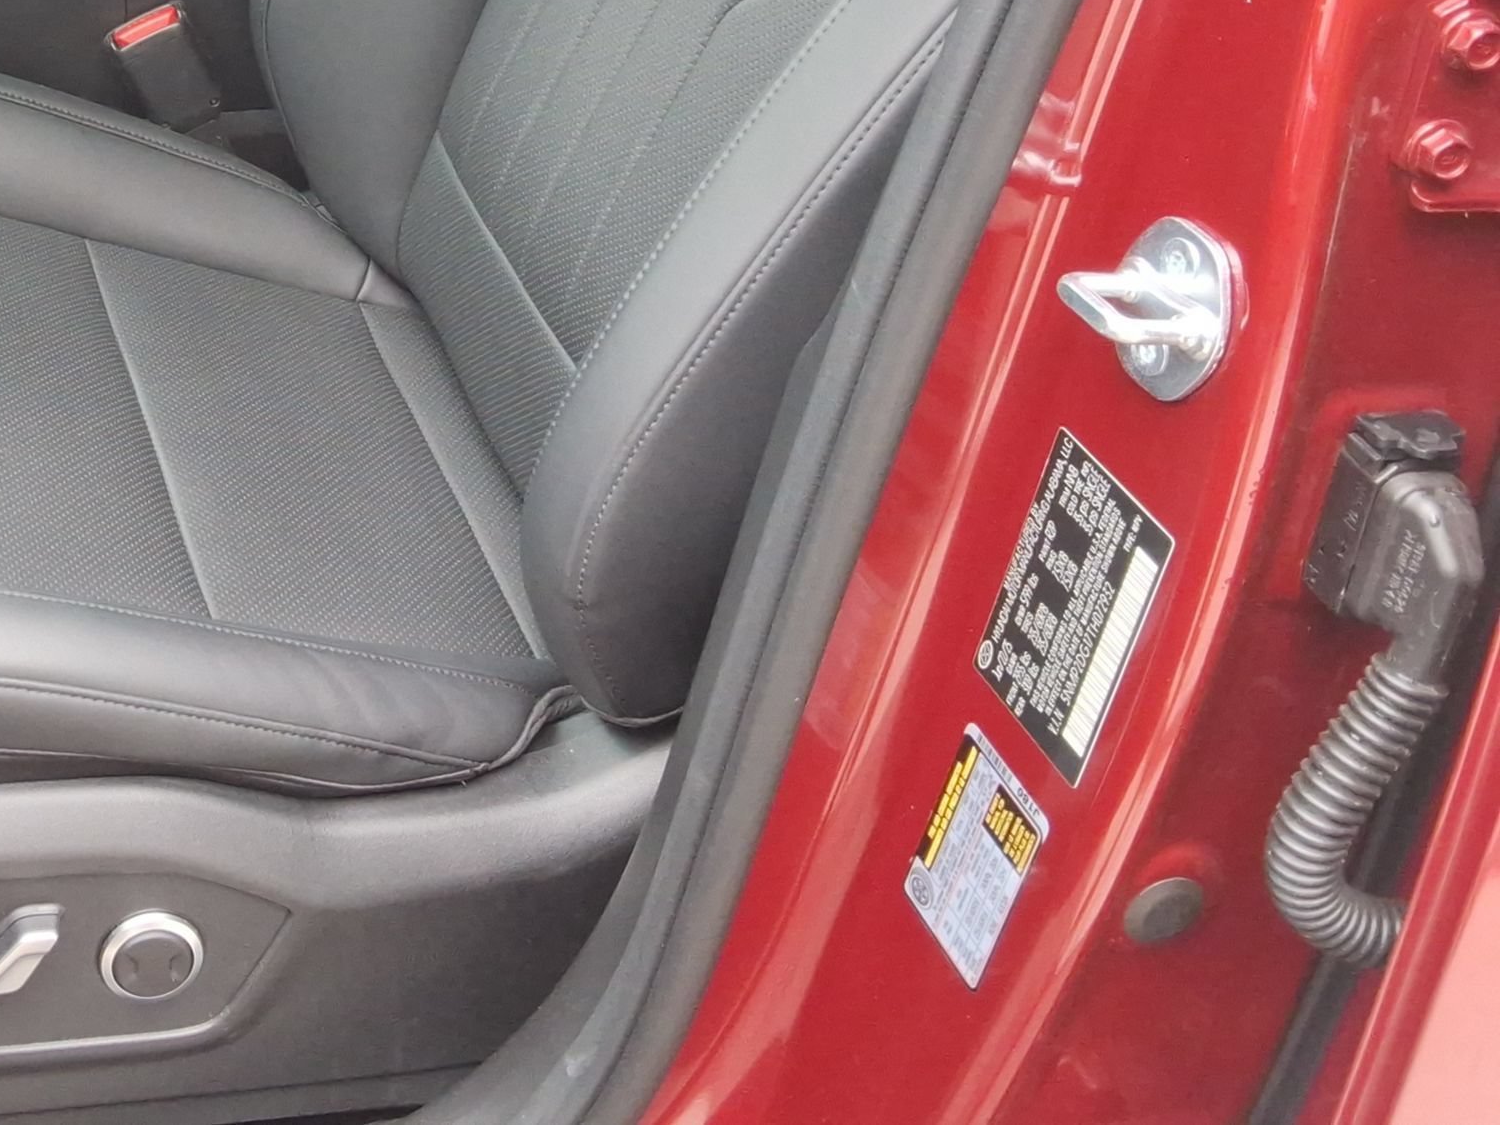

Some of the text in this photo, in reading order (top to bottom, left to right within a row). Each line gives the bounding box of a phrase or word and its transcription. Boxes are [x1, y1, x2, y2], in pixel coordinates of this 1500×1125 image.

[1058, 486, 1070, 508] TRIM
[1081, 465, 1101, 503] SINGLE
[1091, 475, 1111, 513] SINGLE
[991, 602, 1011, 644] HYUNDAI
[1005, 571, 1022, 607] MOTOR
[1016, 498, 1049, 577] MANUFACTURING
[1059, 436, 1073, 459] LLC
